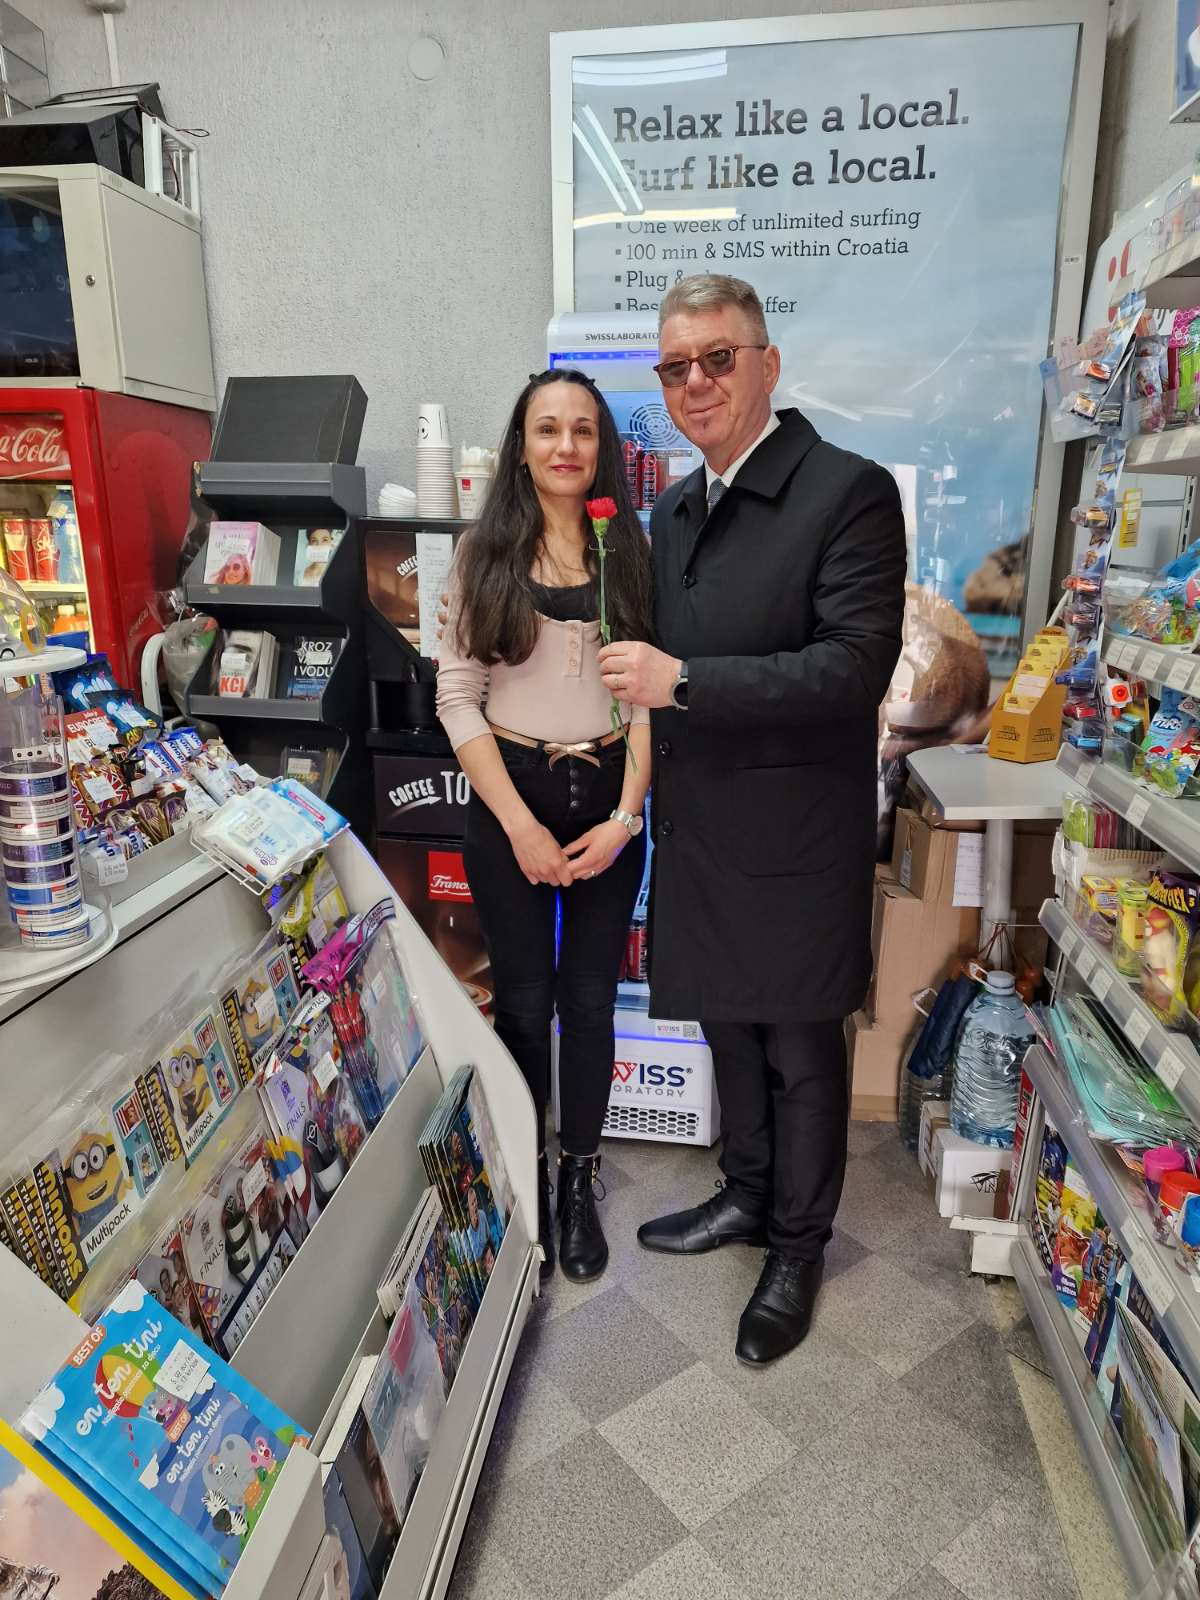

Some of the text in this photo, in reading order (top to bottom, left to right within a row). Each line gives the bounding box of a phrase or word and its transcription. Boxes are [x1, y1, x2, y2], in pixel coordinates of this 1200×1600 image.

[613, 88, 970, 143] Relax like a local.
[616, 145, 936, 192] Surf like a local.
[627, 207, 921, 234] One week of unlimited surfing
[626, 238, 909, 260] 100 min & SMS within Croatia
[626, 270, 668, 291] Plug
[627, 296, 798, 313] Bes ffer
[584, 332, 660, 341] SWISSLABORATO
[301, 641, 333, 652] KROZ
[388, 771, 471, 807] COFFEE TO
[430, 874, 470, 890] Franc
[612, 1061, 687, 1087] WISS
[613, 1084, 686, 1098] ORATORY
[185, 1110, 215, 1151] Multipack
[44, 1200, 57, 1236] RISE
[59, 1258, 74, 1288] GRU
[85, 1202, 132, 1255] Multipack
[72, 1326, 105, 1364] BEST OF
[76, 1318, 163, 1436] en ten tini
[166, 1461, 185, 1484] en
[176, 1429, 202, 1458] ten
[194, 1397, 221, 1428] tini
